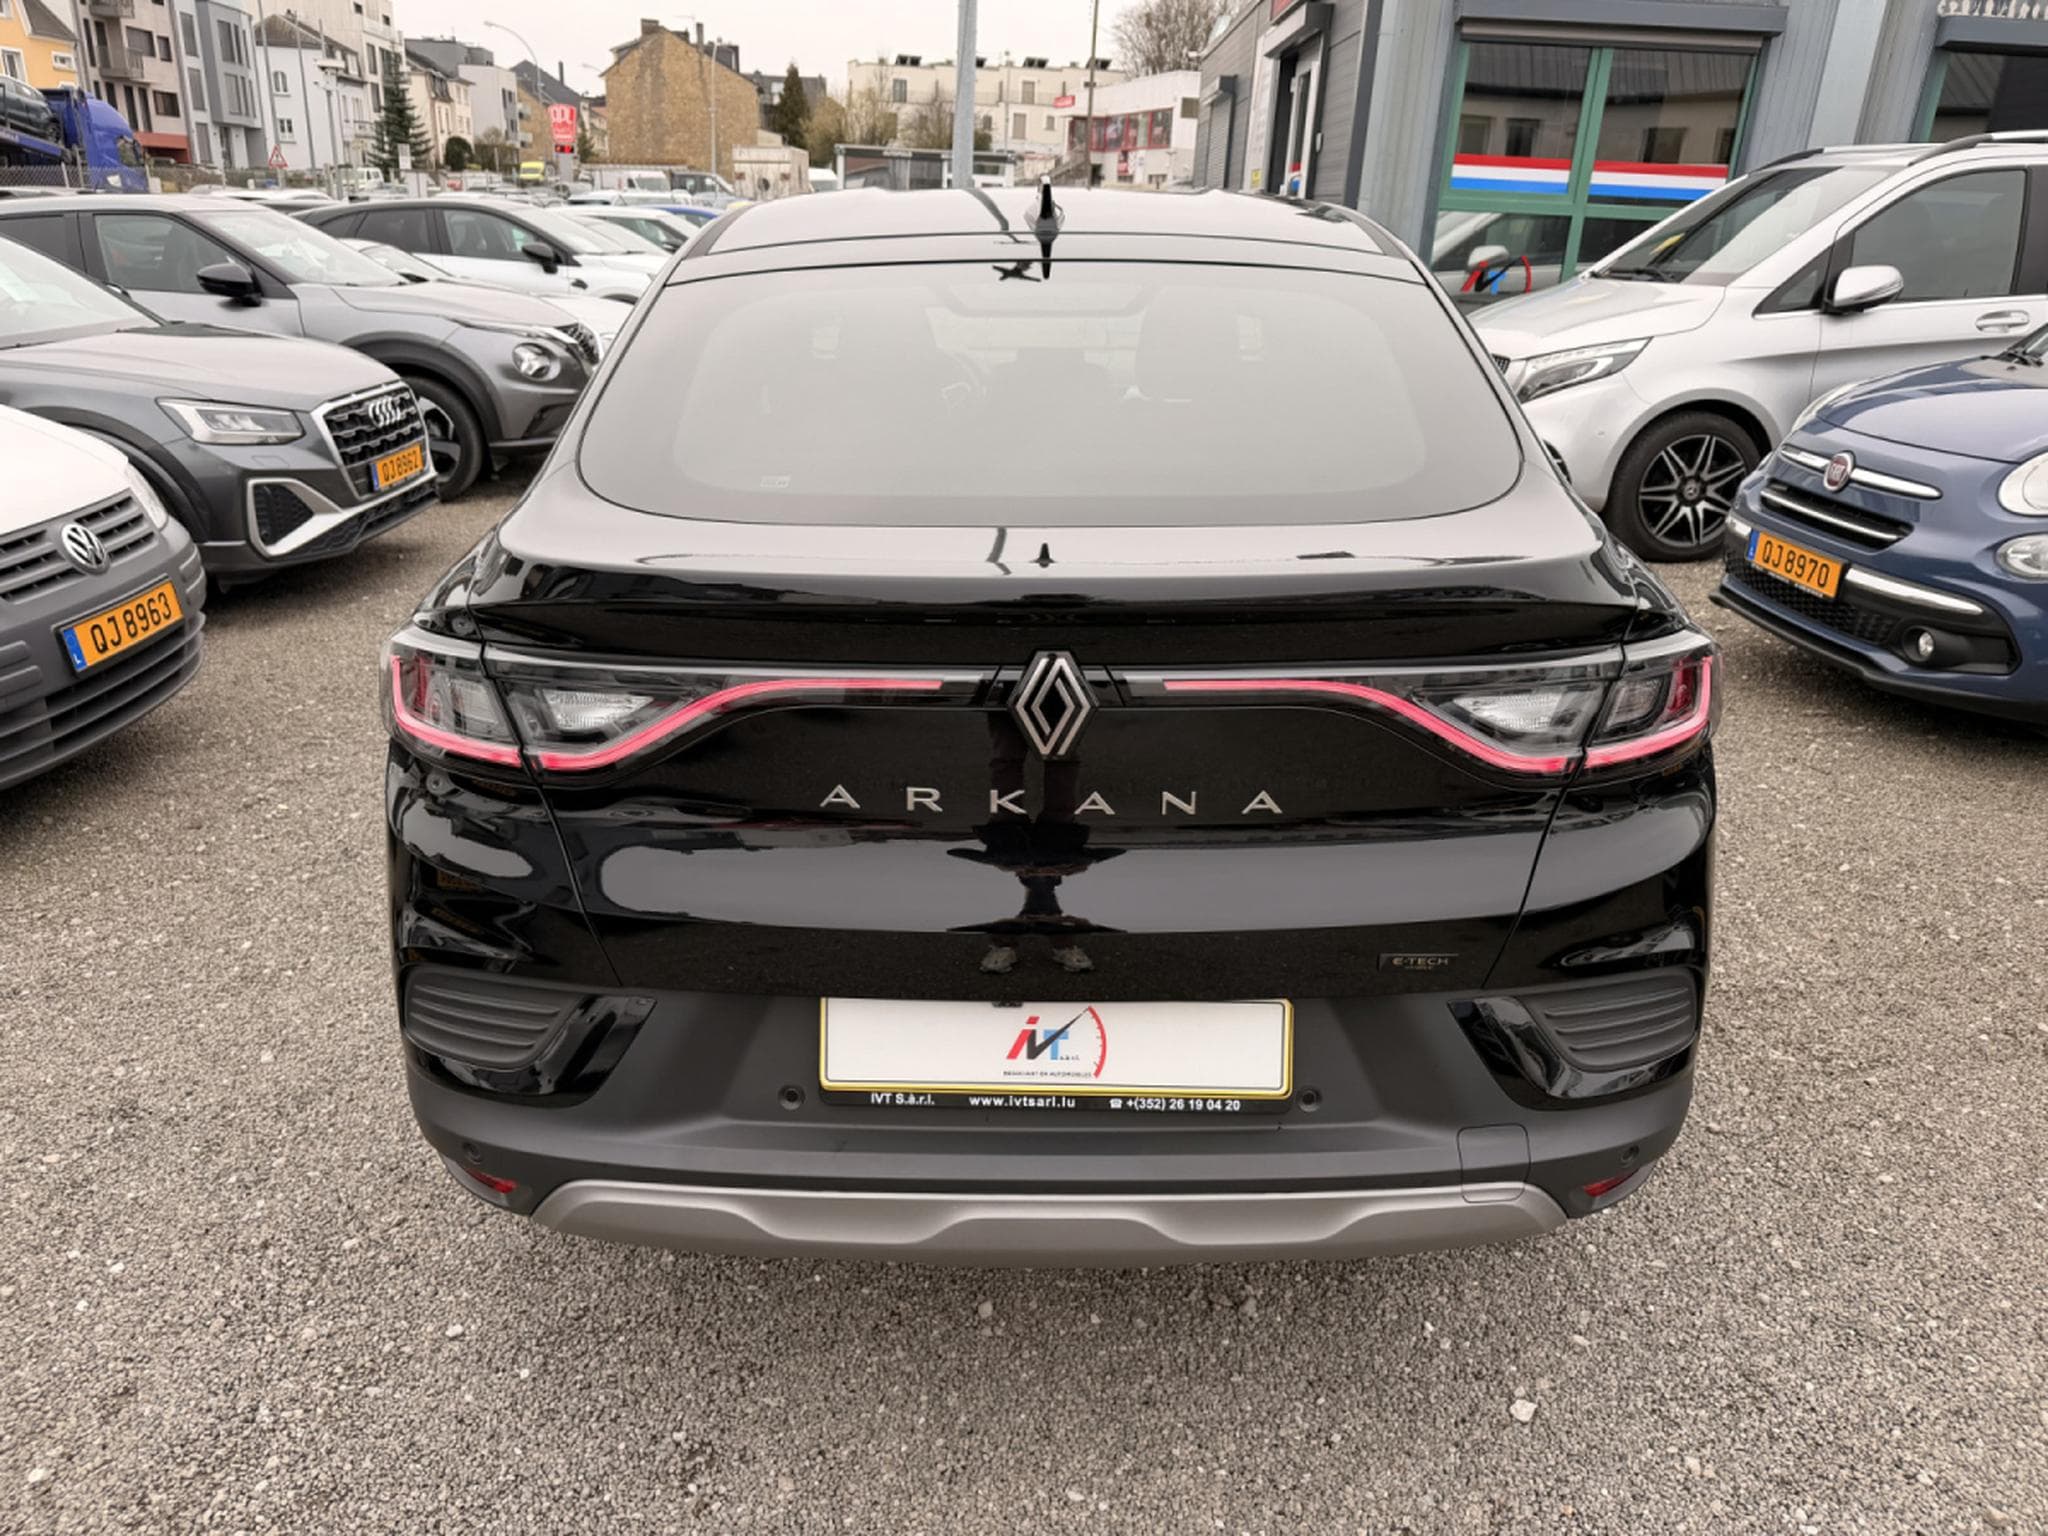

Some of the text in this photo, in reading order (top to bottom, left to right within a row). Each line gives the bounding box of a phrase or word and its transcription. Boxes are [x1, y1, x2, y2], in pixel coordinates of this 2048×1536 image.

[820, 784, 1283, 816] ARKANA
[871, 1093, 893, 1105] IVT
[968, 1095, 1076, 1108] www.ivtsarl.lu
[1126, 1096, 1241, 1111] +(352) 26 19 04 20
